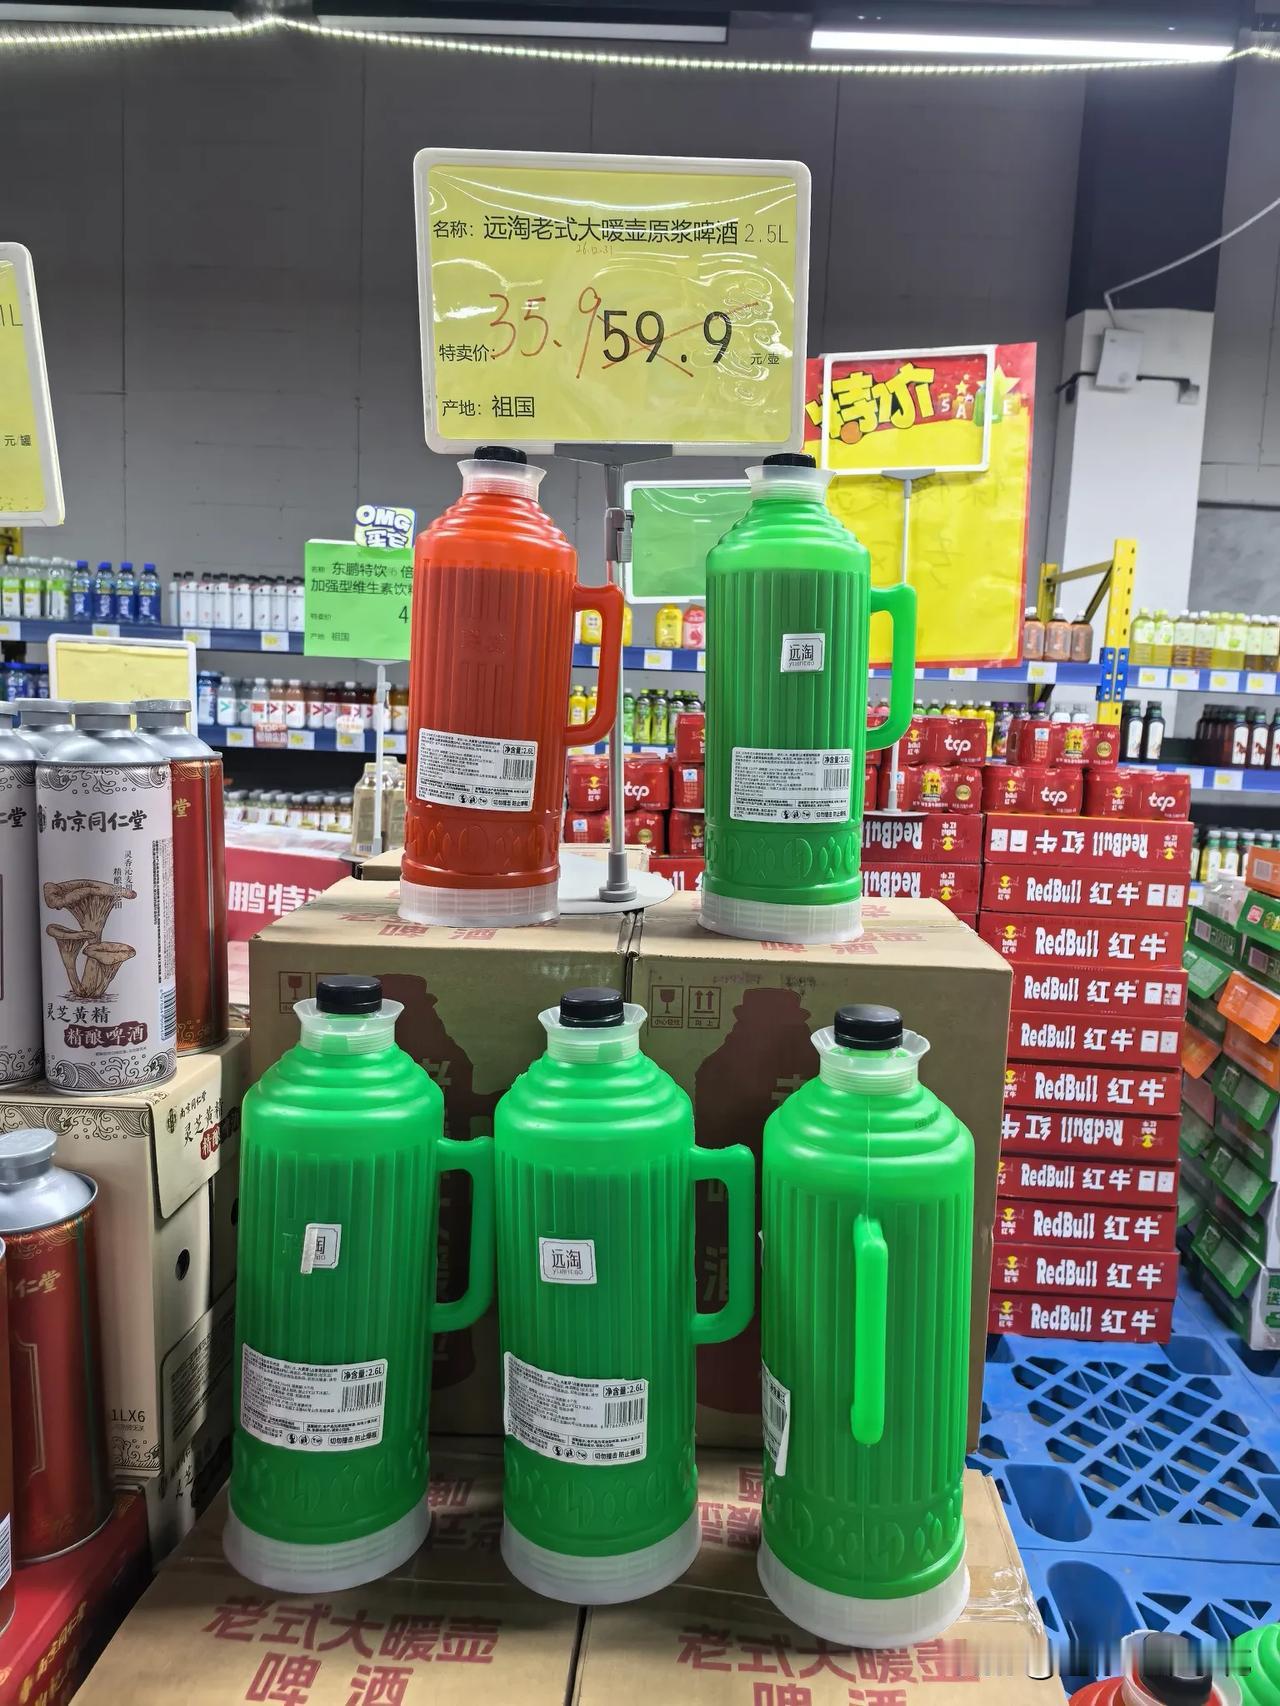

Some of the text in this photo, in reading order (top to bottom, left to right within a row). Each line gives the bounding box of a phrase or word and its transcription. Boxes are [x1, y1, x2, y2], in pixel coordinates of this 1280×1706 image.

[483, 215, 738, 245] 远淘老式大暖壶原浆啤酒
[745, 223, 789, 244] 2.5L
[603, 310, 733, 364] 59.9
[750, 353, 780, 365] 元/壶
[491, 396, 536, 418] 祖国
[356, 505, 412, 533] OMG
[332, 561, 387, 578] 东鹏特饮
[789, 644, 814, 661] 远淘
[943, 734, 972, 756] tcp
[624, 781, 649, 801] tcp
[1040, 786, 1068, 807] tcp
[1148, 792, 1176, 811] tcp
[51, 809, 148, 832] 南京同仁堂
[863, 821, 923, 850] RedBul
[1035, 829, 1149, 858] 红牛 RedBull
[862, 871, 922, 898] RedBul
[1026, 877, 1140, 907] RedBull 红牛
[1035, 926, 1167, 960] RedBull 红牛
[1024, 975, 1137, 1005] RedBull 红牛
[47, 1002, 111, 1024] 灵芝黄精
[67, 1023, 145, 1046] 精酿啤酒
[1021, 1023, 1134, 1052] RedBull 红牛
[1035, 1072, 1165, 1105] RedBull 红牛
[1001, 1113, 1124, 1147] 红牛 RedBull
[1021, 1163, 1132, 1192] RedBull 红牛
[1033, 1209, 1160, 1242] RedBull 红牛
[551, 1249, 581, 1270] 远淘
[1036, 1257, 1162, 1290] RedBull 红牛
[1030, 1303, 1157, 1335] RedBull 红牛
[112, 1408, 146, 1423] 1LX6
[202, 1595, 502, 1664] 老式大暖壶
